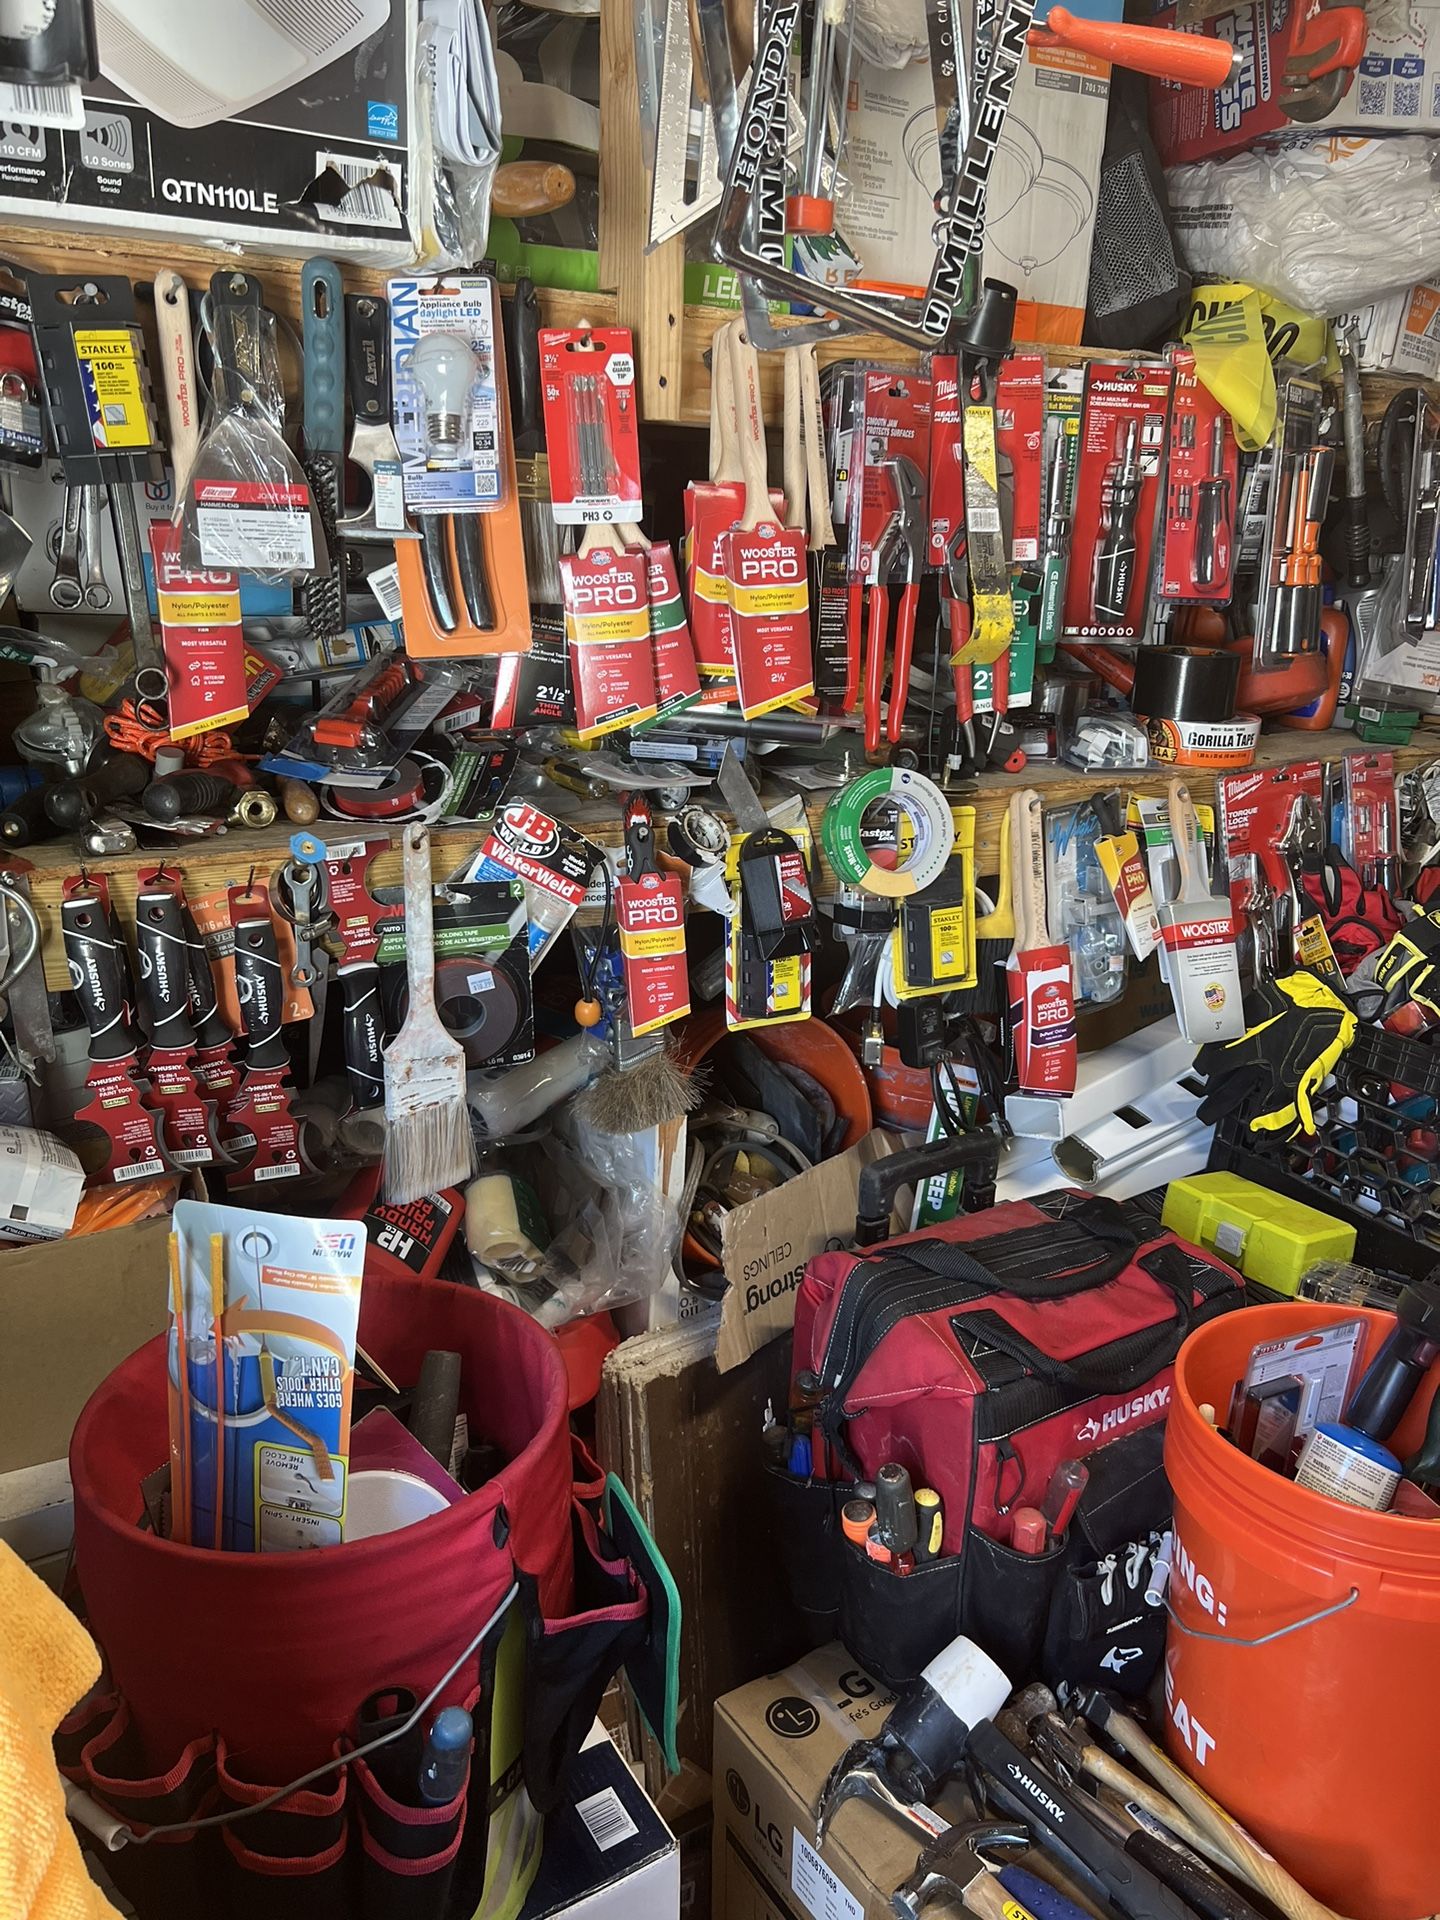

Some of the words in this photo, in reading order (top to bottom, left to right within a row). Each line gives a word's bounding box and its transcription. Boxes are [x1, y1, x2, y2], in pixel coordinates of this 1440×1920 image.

[1258, 2, 1270, 99] PROFESSIONAL
[731, 4, 798, 193] HONDA
[16, 147, 42, 159] CFM
[84, 155, 99, 166] 1.0
[101, 156, 132, 170] Sones
[0, 164, 46, 178] erformance
[97, 175, 122, 186] Sound
[100, 185, 121, 194] Sonido
[161, 178, 280, 214] QTN110LE
[420, 301, 461, 310] Appliance
[463, 300, 482, 308] Bulb
[420, 309, 457, 318] daylight
[460, 308, 480, 317] LED
[543, 332, 571, 343] Milwaukee
[81, 345, 127, 354] STANLEY
[95, 361, 115, 371] 100
[176, 356, 186, 381] PRO
[365, 340, 377, 386] Anvil
[612, 366, 631, 374] GUARD
[868, 375, 892, 388] Milwaukee
[748, 382, 757, 406] PRO
[177, 383, 190, 427] WOOSTER
[1058, 403, 1073, 411] Driver
[934, 410, 959, 418] REAM
[749, 407, 760, 442] WOOSTER
[866, 416, 886, 427] SMOOTH
[887, 418, 899, 427] JAW
[5, 430, 42, 447] Master
[866, 426, 890, 436] PROTECTS
[890, 428, 915, 439] SURFACES
[145, 503, 158, 512] Buy
[582, 511, 600, 522] PH3
[740, 541, 797, 559] WOOSTER
[573, 567, 636, 586] WOOSTER
[741, 559, 798, 580] PRO
[573, 585, 637, 608] PRO
[750, 592, 795, 602] Nylon/Polyester
[1047, 581, 1057, 615] Commercial
[171, 601, 230, 611] Nylon/Polyester
[582, 619, 634, 630] Nylon/Polyester
[756, 626, 770, 634] MOST
[1045, 615, 1055, 631] Electric
[590, 653, 606, 662] MOST
[606, 652, 632, 661] VERSATILE
[534, 708, 562, 717] ANGLE
[539, 702, 560, 710] THIN
[1188, 731, 1234, 747] GORILLA
[1236, 733, 1255, 747] TAPE
[1226, 772, 1263, 798] Milwaukee
[1228, 806, 1258, 817] TORQUE
[1228, 815, 1249, 825] LOCK
[561, 858, 587, 875] Strongest
[567, 854, 586, 868] World's
[843, 845, 866, 878] Pro-Mask
[490, 841, 576, 898] WaterWeld
[1126, 871, 1145, 887] PRO
[513, 883, 521, 896] 2
[191, 901, 210, 911] CABLE
[627, 892, 676, 909] WOOSTER
[628, 907, 678, 926] PRO
[933, 915, 960, 923] STANLEY
[383, 925, 401, 933] AUTO
[436, 930, 464, 939] MOLDING
[464, 929, 479, 937] TAPE
[1180, 920, 1230, 938] WOOSTER
[453, 937, 468, 945] ALTA
[468, 933, 506, 943] RESISTENCIA
[634, 935, 677, 945] Nylon/Polyester
[84, 956, 104, 999] HUSKY
[158, 951, 169, 992] HUSKY
[254, 973, 268, 1012] HUSKY
[290, 1001, 300, 1018] 2
[1037, 997, 1068, 1011] WOOSTER
[1037, 1007, 1068, 1024] PRO
[366, 1021, 378, 1063] HUSKY
[98, 1085, 119, 1093] 15-IN-1
[374, 1205, 432, 1246] HANDY
[377, 1230, 415, 1260] HP
[742, 1240, 792, 1279] CEILINGS
[746, 1262, 804, 1314] strong
[277, 1376, 309, 1392] TOOLS
[309, 1377, 341, 1393] OTHER
[277, 1391, 316, 1409] WHERE
[317, 1392, 343, 1409] GOES
[265, 1450, 288, 1460] CLOG
[289, 1456, 304, 1464] THE
[265, 1458, 300, 1471] REMOVE
[265, 1509, 283, 1521] SPIN
[291, 1515, 320, 1527] INSERT
[1172, 1535, 1227, 1628] ING:
[754, 1802, 785, 1858] LG
